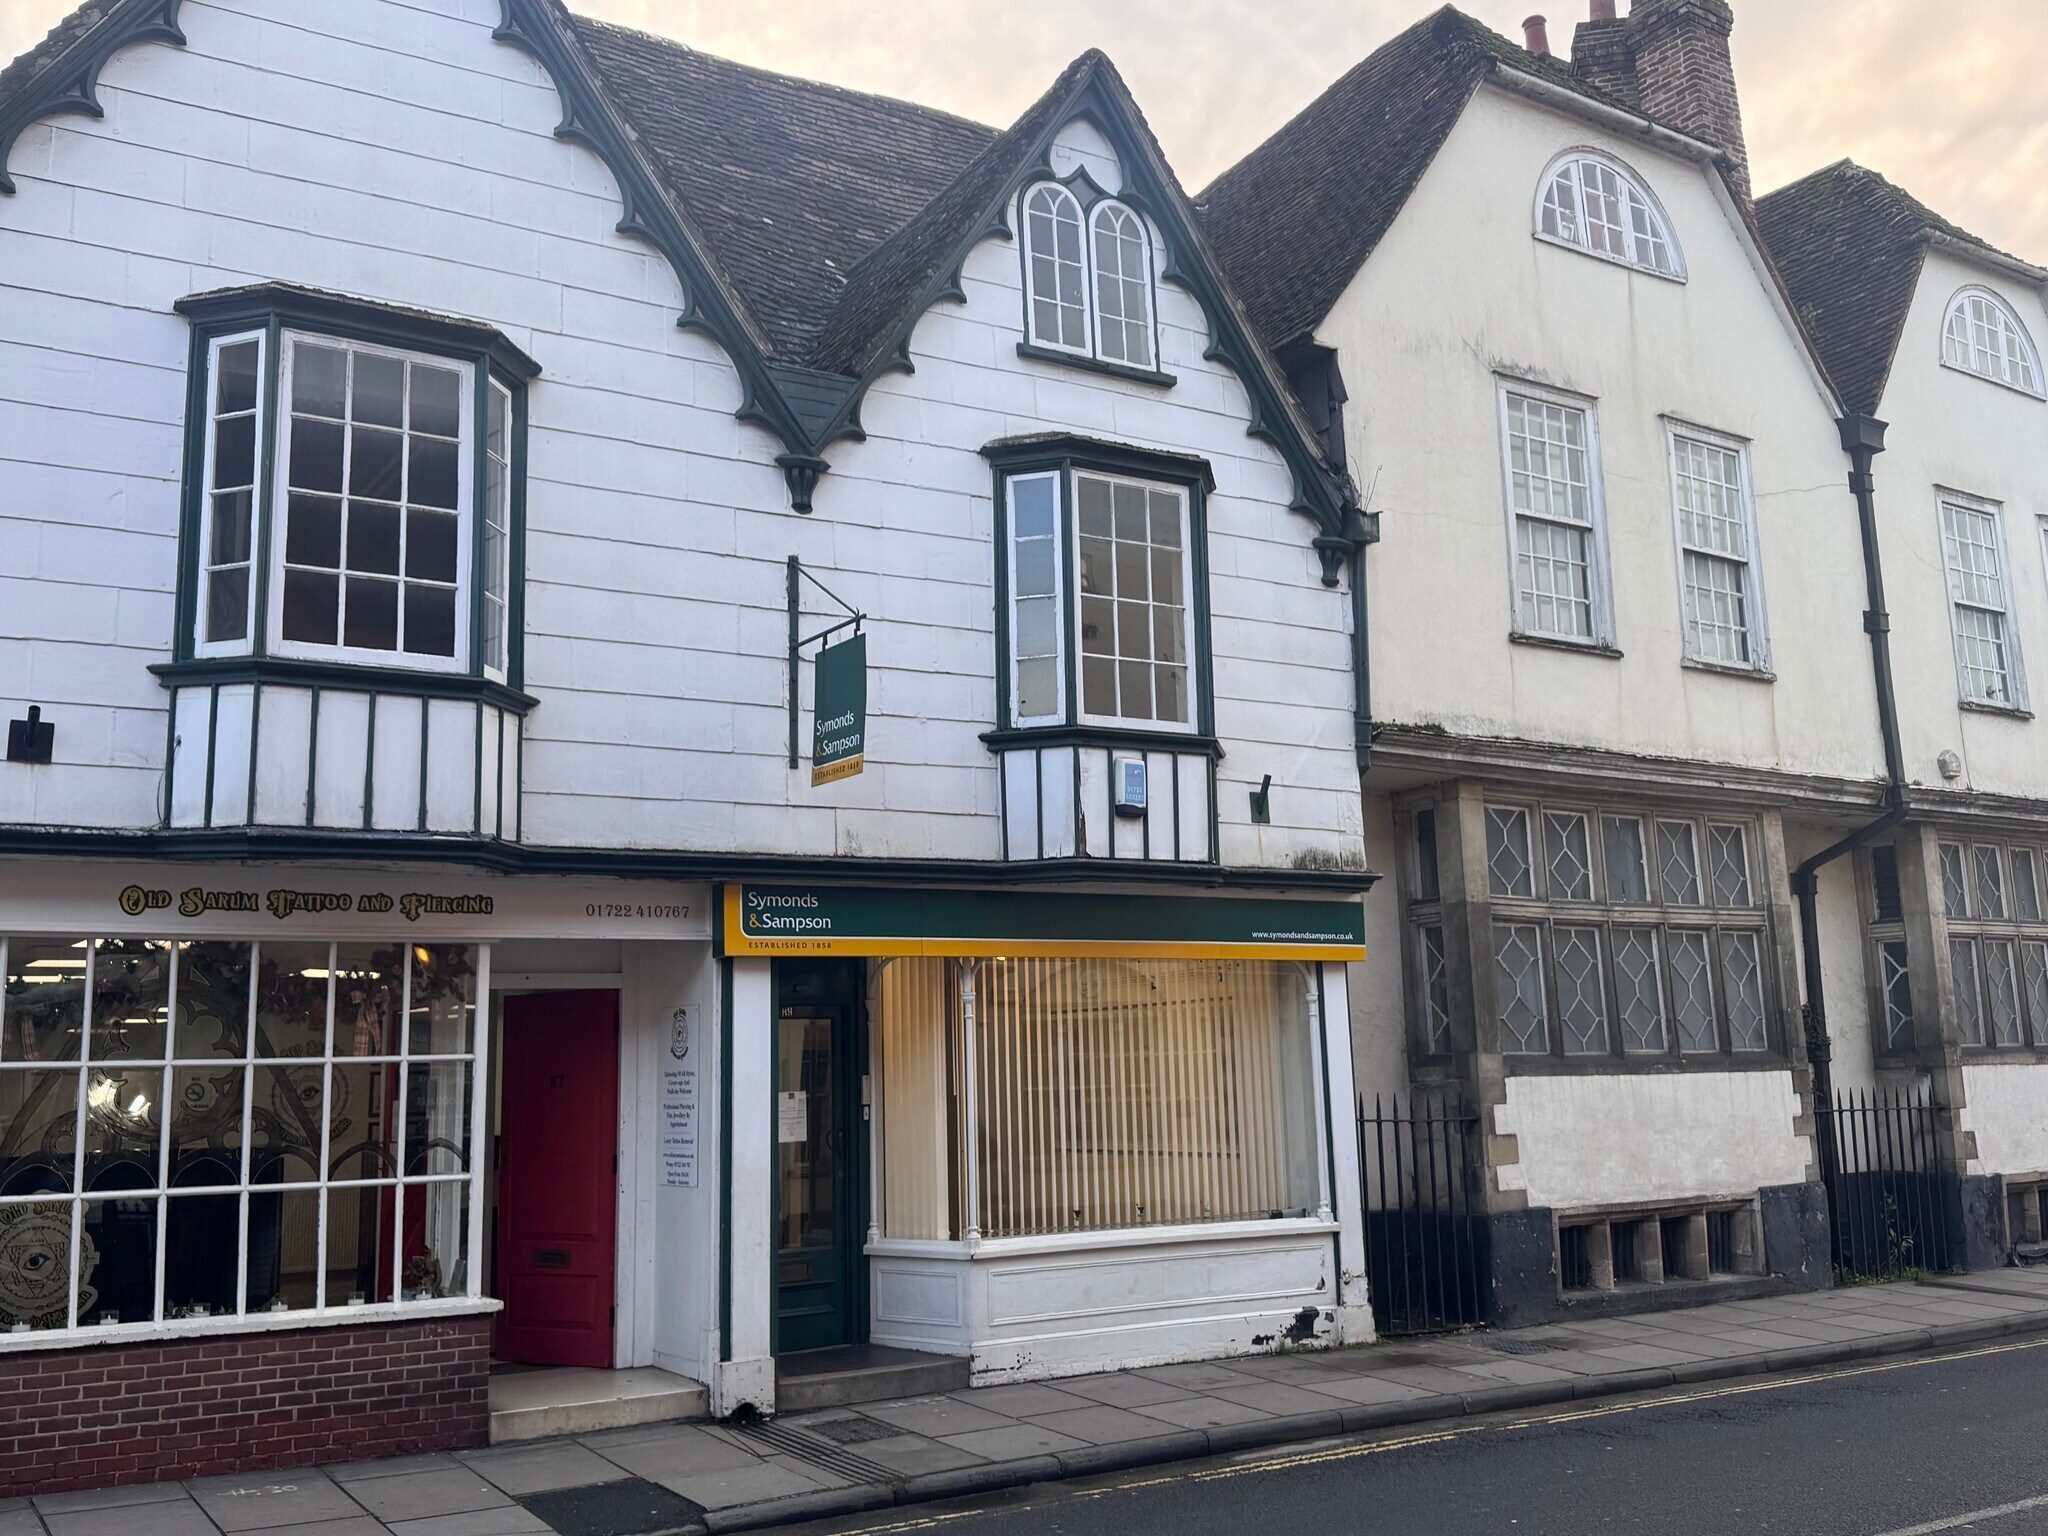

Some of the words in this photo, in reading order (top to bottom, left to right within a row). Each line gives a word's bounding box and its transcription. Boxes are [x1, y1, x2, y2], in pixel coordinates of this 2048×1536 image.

[816, 710, 854, 738] Symonds
[748, 891, 819, 910] Symonds
[586, 904, 632, 917] 01722
[636, 905, 690, 918] 410767
[1251, 931, 1353, 940] www.symondsandsampson.co.uk
[550, 1074, 564, 1089] 87
